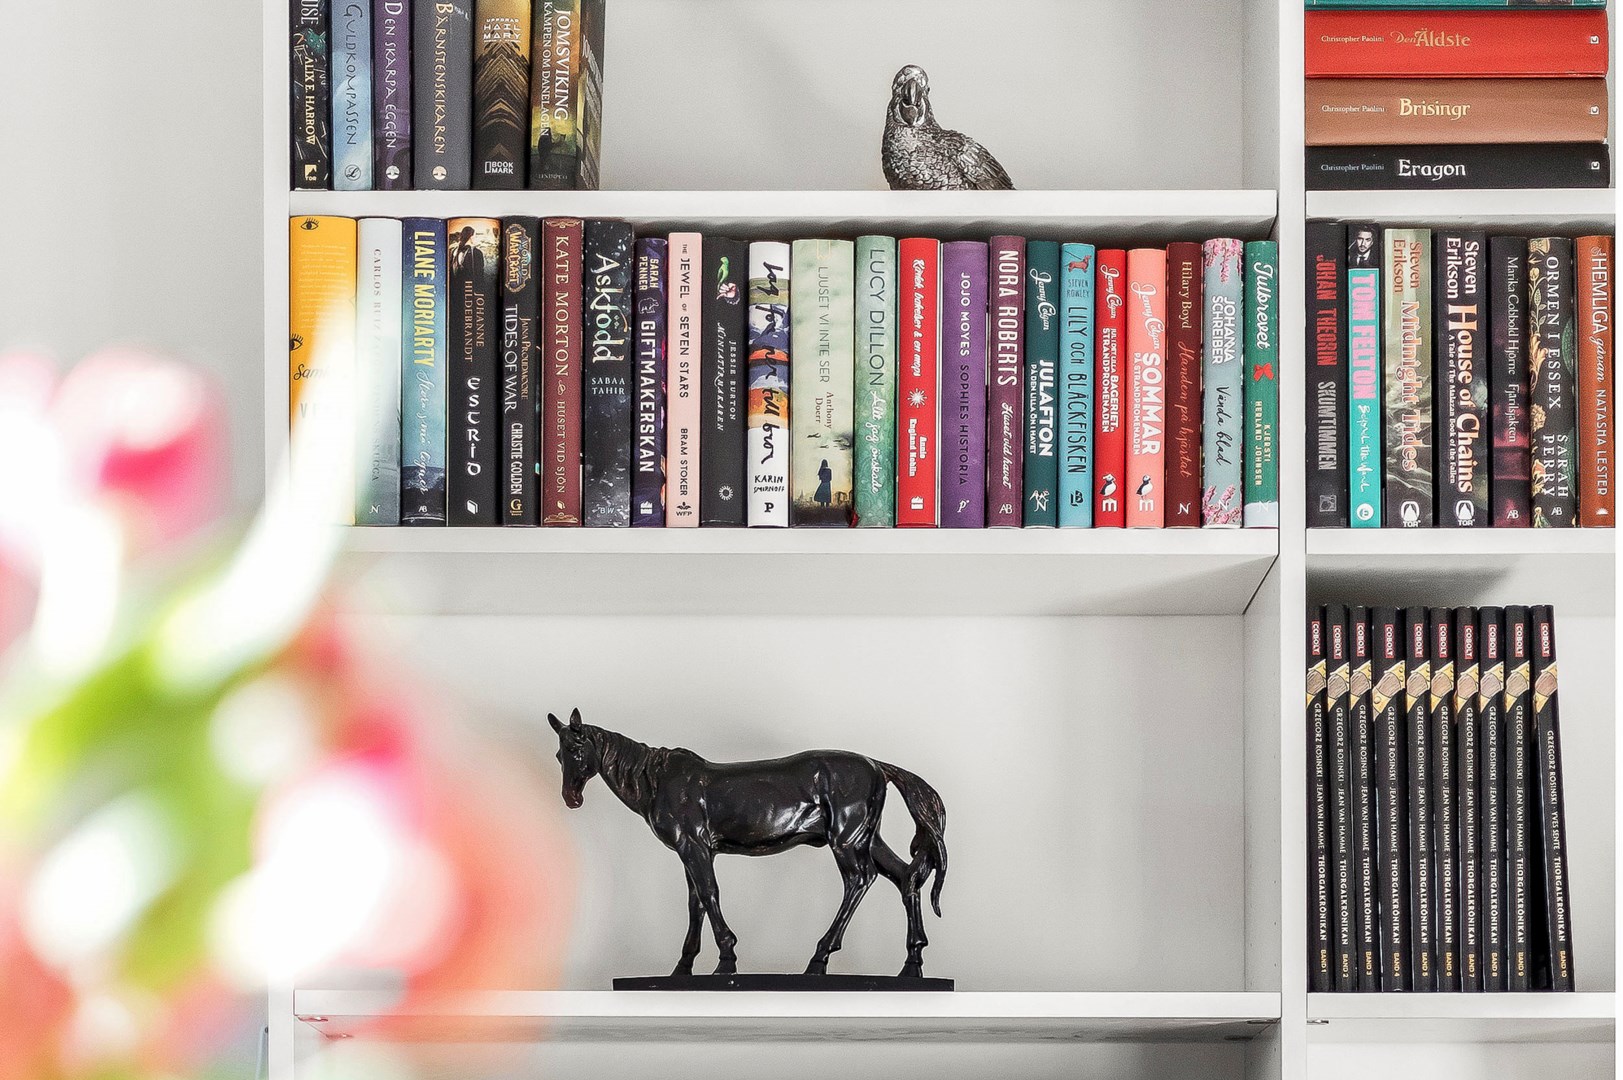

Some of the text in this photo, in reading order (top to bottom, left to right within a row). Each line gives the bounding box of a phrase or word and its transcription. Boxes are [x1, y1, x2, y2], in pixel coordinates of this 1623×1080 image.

[483, 32, 521, 40] MARY
[484, 23, 521, 31] HAIL
[540, 2, 552, 136] KAMPEN OM DANELAGEN
[554, 9, 571, 120] JOMSVIKING
[1321, 35, 1360, 44] Christopher
[1415, 28, 1471, 48] Äldste
[305, 57, 316, 145] ALIX HARROW
[344, 4, 363, 145] GULDKOMPASSEN
[384, 2, 403, 149] DEN SKARPA EGGEN
[434, 3, 453, 154] BÄRNSTENSKIKAREN
[1399, 98, 1471, 121] Brisingr
[1398, 159, 1467, 181] Eragon
[414, 232, 436, 367] LIANE MORIARTY
[556, 236, 569, 376] KATE MORTON
[590, 253, 628, 363] Askfödd
[639, 256, 648, 290] PENNER
[649, 258, 658, 288] SARAH
[1178, 261, 1193, 328] Hilary Boyd
[1253, 262, 1274, 349] Julbrevet
[1316, 255, 1337, 365] JOHAN THEORIN
[1447, 237, 1462, 298] Erikson
[1464, 241, 1479, 294] Steven
[1591, 258, 1608, 334] HEMLIGA
[464, 281, 474, 362] HILDEBRANDT
[475, 293, 485, 347] JOHANNE
[680, 258, 690, 398] JEWEL SEVEN STARS
[818, 266, 830, 383] LJUSET VI INTE SER
[869, 249, 885, 386] LUCY DILLON
[960, 272, 970, 356] JOJO MOYES
[997, 251, 1019, 386] NORA ROBERTS
[1212, 295, 1224, 364] SCHREIBER
[1223, 297, 1236, 362] JOHANNA
[1352, 274, 1376, 399] TOM FELTON
[1546, 257, 1561, 409] ORMEN ESSEX
[504, 304, 518, 414] TIDES OF WAR
[591, 378, 625, 386] SABAA
[592, 387, 625, 395] TAHIR
[639, 320, 656, 472] GIFTMAKERSKAN
[1067, 306, 1091, 474] LILY OCH BLÄCKFISKEN
[1395, 300, 1422, 472] Midnight Tides
[1447, 304, 1480, 493] House of Chains
[557, 401, 567, 493] HUSET VID SJÖN
[959, 365, 970, 485] SOPHIES HISTORIA
[1039, 360, 1053, 456] JULAFTON
[1142, 353, 1161, 454] SOMMAR
[1216, 387, 1232, 465] Vända blad
[1596, 389, 1608, 496] NATASHA LESTER
[509, 423, 523, 494] CHRISTIE GOLDEN
[680, 428, 689, 496] BRAM STOKER
[1391, 859, 1401, 944] THORGALKRÖNIKAN
[1553, 857, 1566, 942] THORGALKRÖNIKAN
